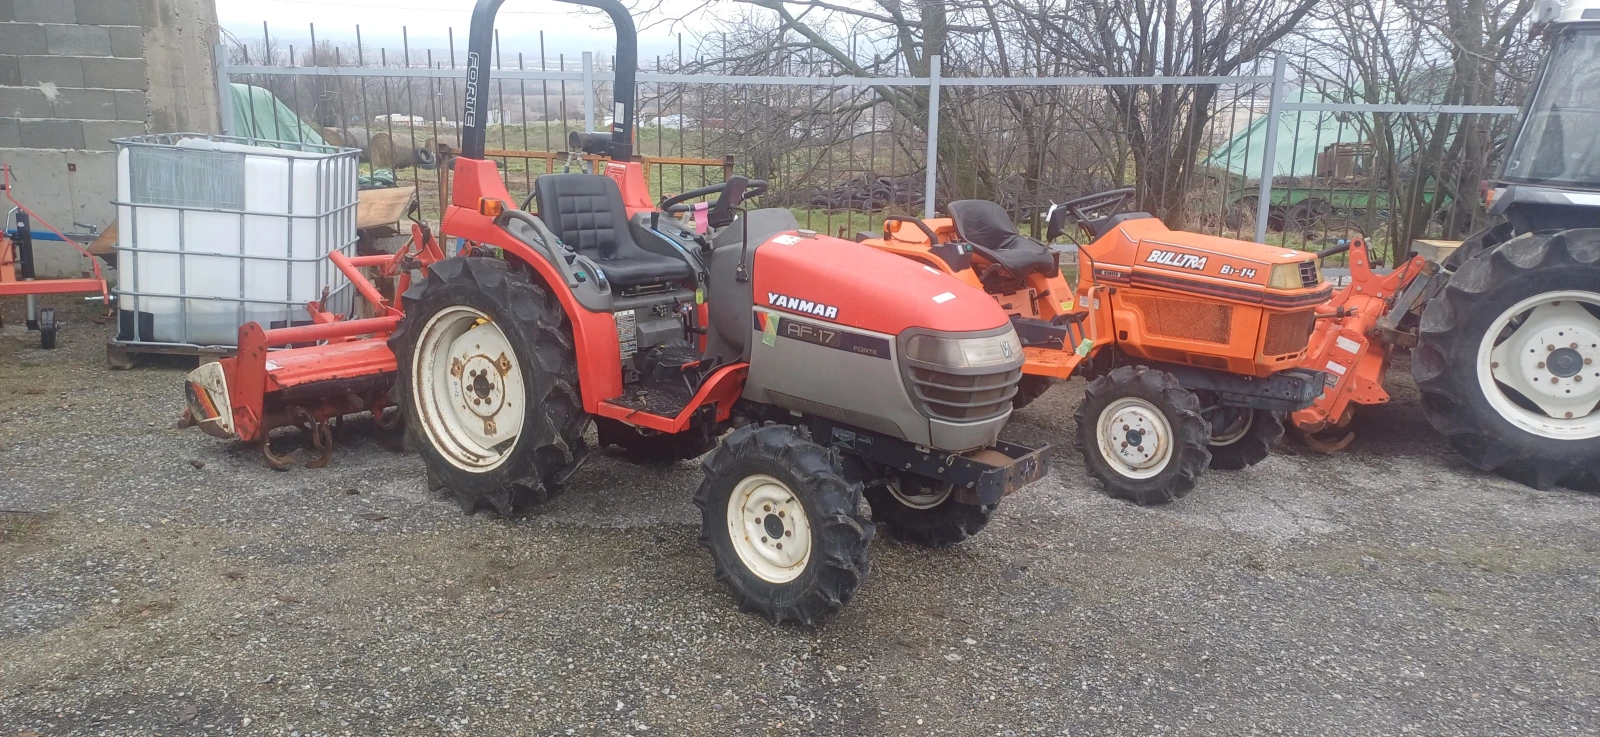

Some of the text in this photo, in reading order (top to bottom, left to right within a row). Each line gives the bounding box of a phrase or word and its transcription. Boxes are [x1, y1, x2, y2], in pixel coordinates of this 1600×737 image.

[465, 52, 479, 127] FORTE
[1146, 249, 1208, 270] BULLTRA
[767, 292, 838, 319] YANMAR
[853, 346, 878, 355] FORTE
